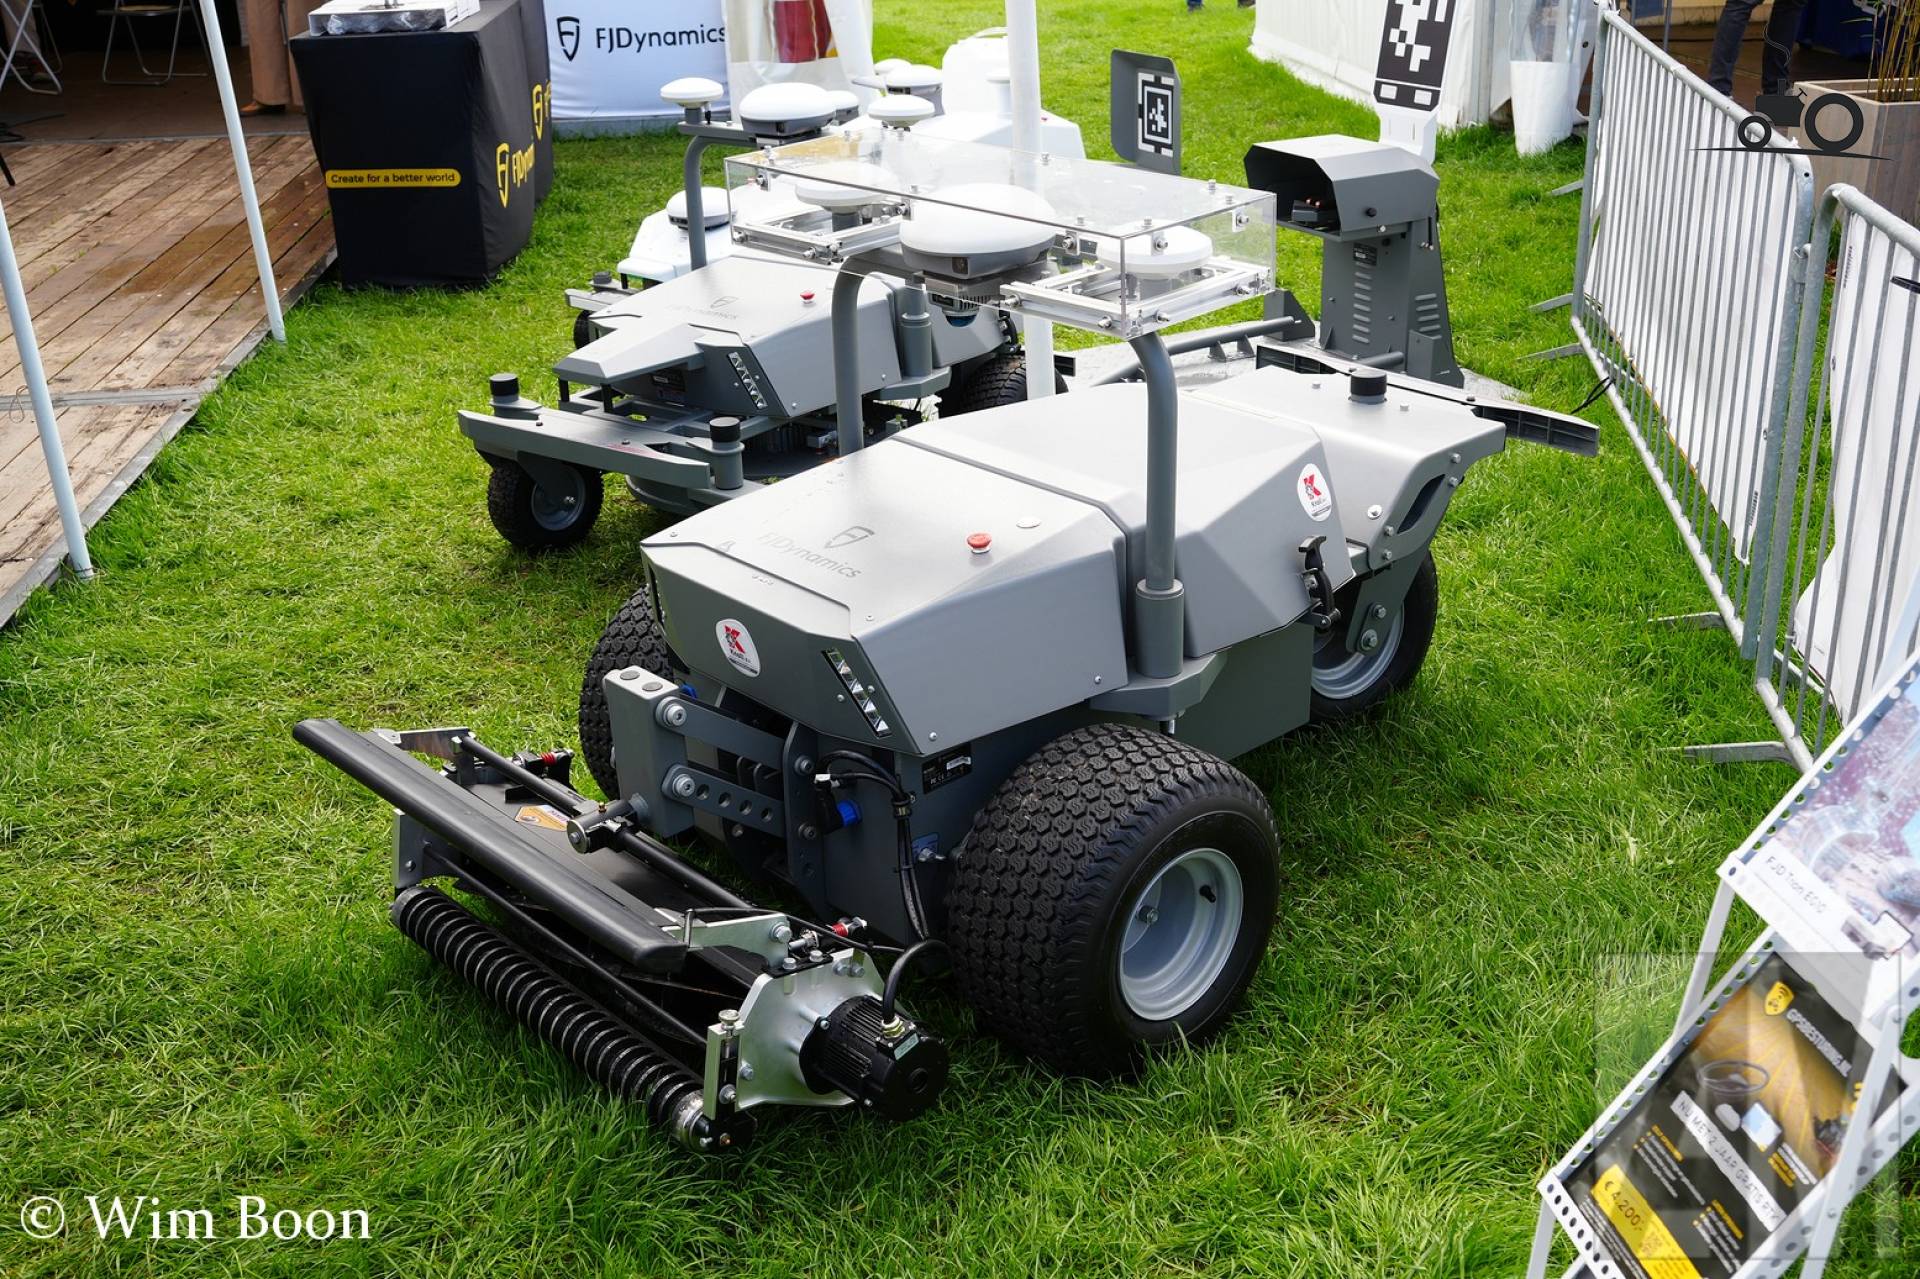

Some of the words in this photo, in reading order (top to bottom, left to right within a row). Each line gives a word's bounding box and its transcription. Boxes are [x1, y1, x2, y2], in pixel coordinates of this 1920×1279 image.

[596, 24, 725, 53] FJDynamics
[331, 173, 364, 183] Create
[367, 173, 380, 183] for
[383, 175, 390, 183] a
[392, 173, 423, 182] better
[426, 172, 455, 182] world
